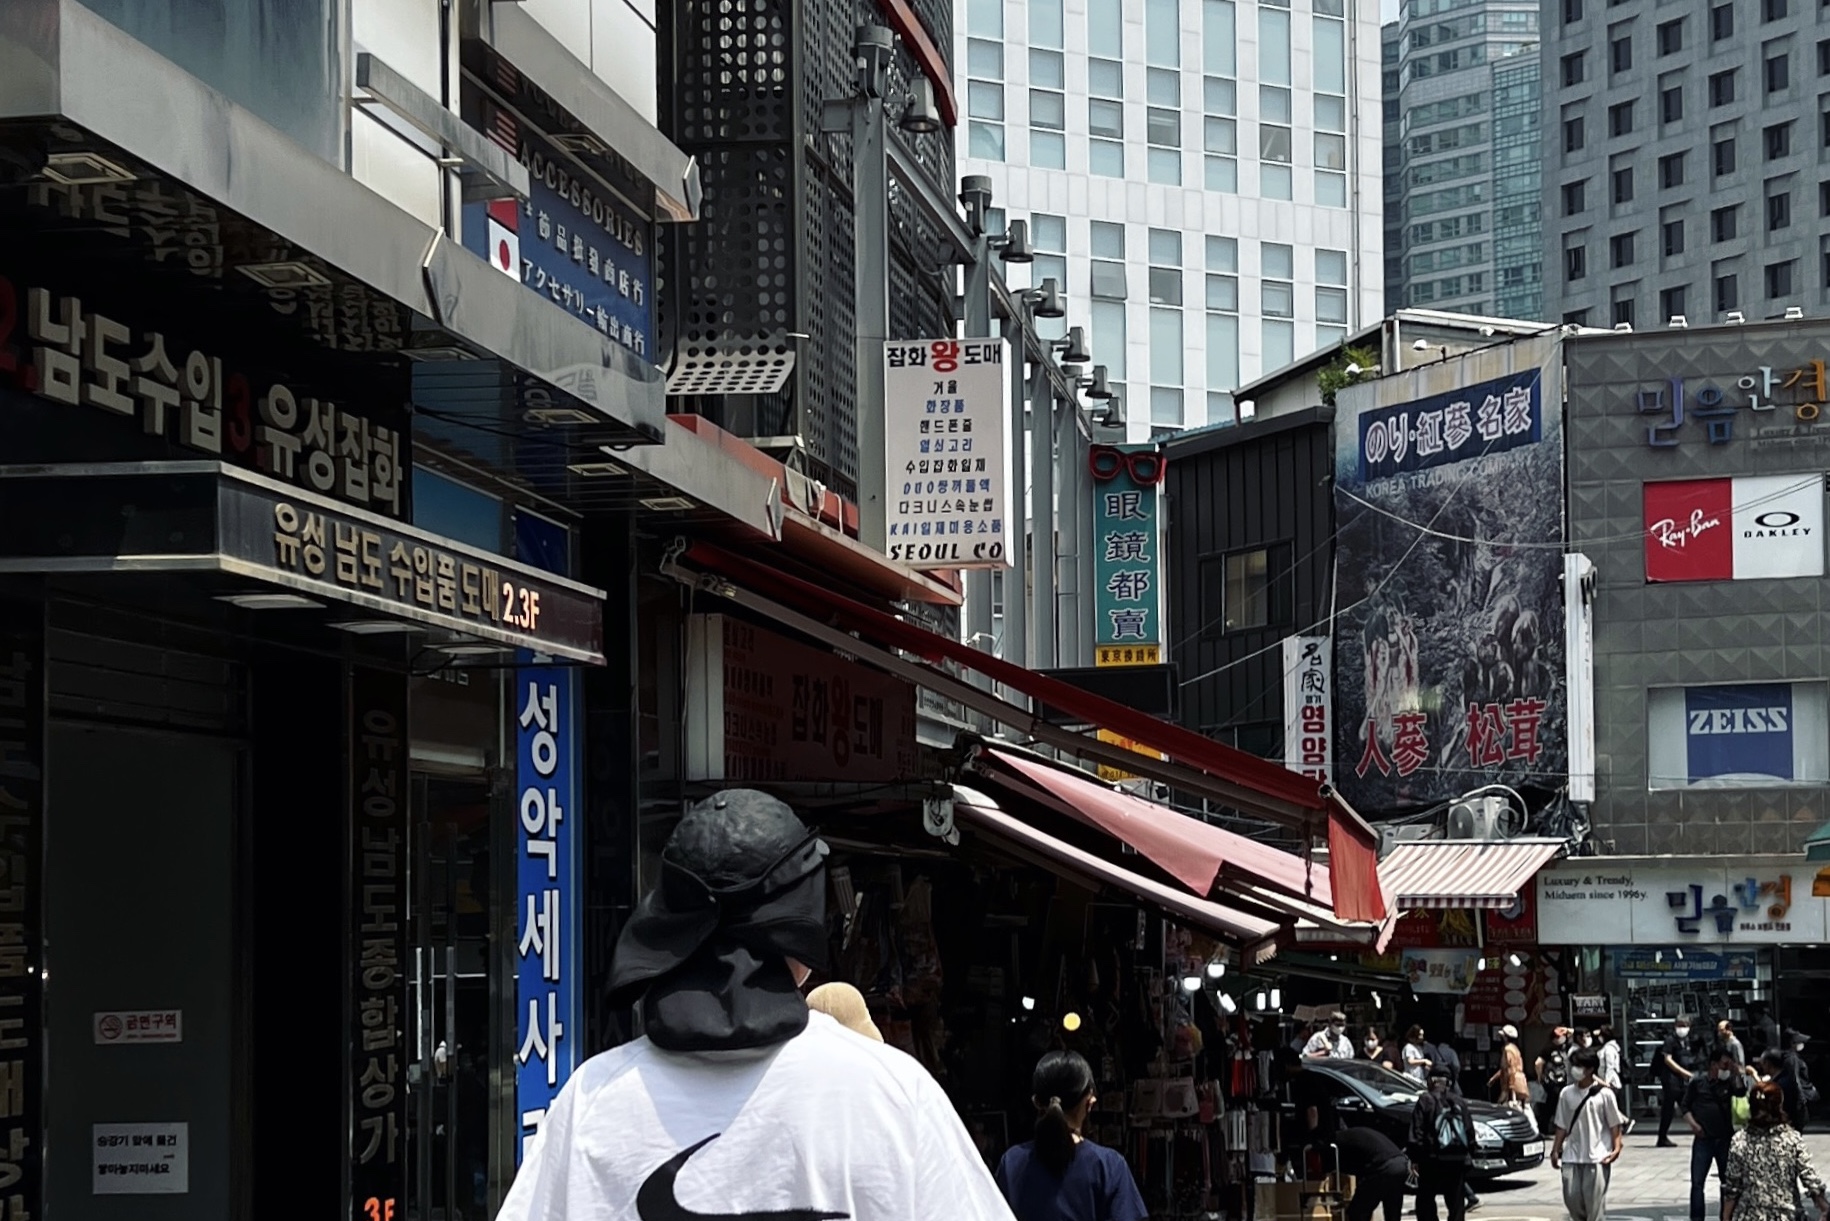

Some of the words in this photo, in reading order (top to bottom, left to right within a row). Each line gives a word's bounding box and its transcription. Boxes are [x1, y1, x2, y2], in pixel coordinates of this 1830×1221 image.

[520, 140, 643, 257] ACCESSORIES
[28, 287, 222, 453] 남도수입
[256, 384, 402, 515] 유성잡화
[926, 399, 964, 414] 화장품
[1366, 480, 1407, 499] KOREA
[1410, 467, 1467, 490] TRADING
[1743, 527, 1811, 539] OAKLEY
[890, 543, 961, 560] SEOUL
[1105, 490, 1150, 639] 眼鏡都賣
[275, 503, 327, 574] 유성
[335, 521, 383, 589] 남도
[390, 541, 456, 610] 수입품
[462, 561, 500, 620] 도매
[503, 582, 541, 630] 2.3F
[1689, 707, 1788, 735] ZEISS
[1356, 710, 1428, 779] 人蔘
[1465, 697, 1546, 767] 松茸
[1544, 876, 1581, 888] Luxury
[1583, 876, 1592, 885] &
[1595, 875, 1634, 887] Trendy,
[1589, 889, 1614, 900] since
[127, 1013, 176, 1030] 금연구역
